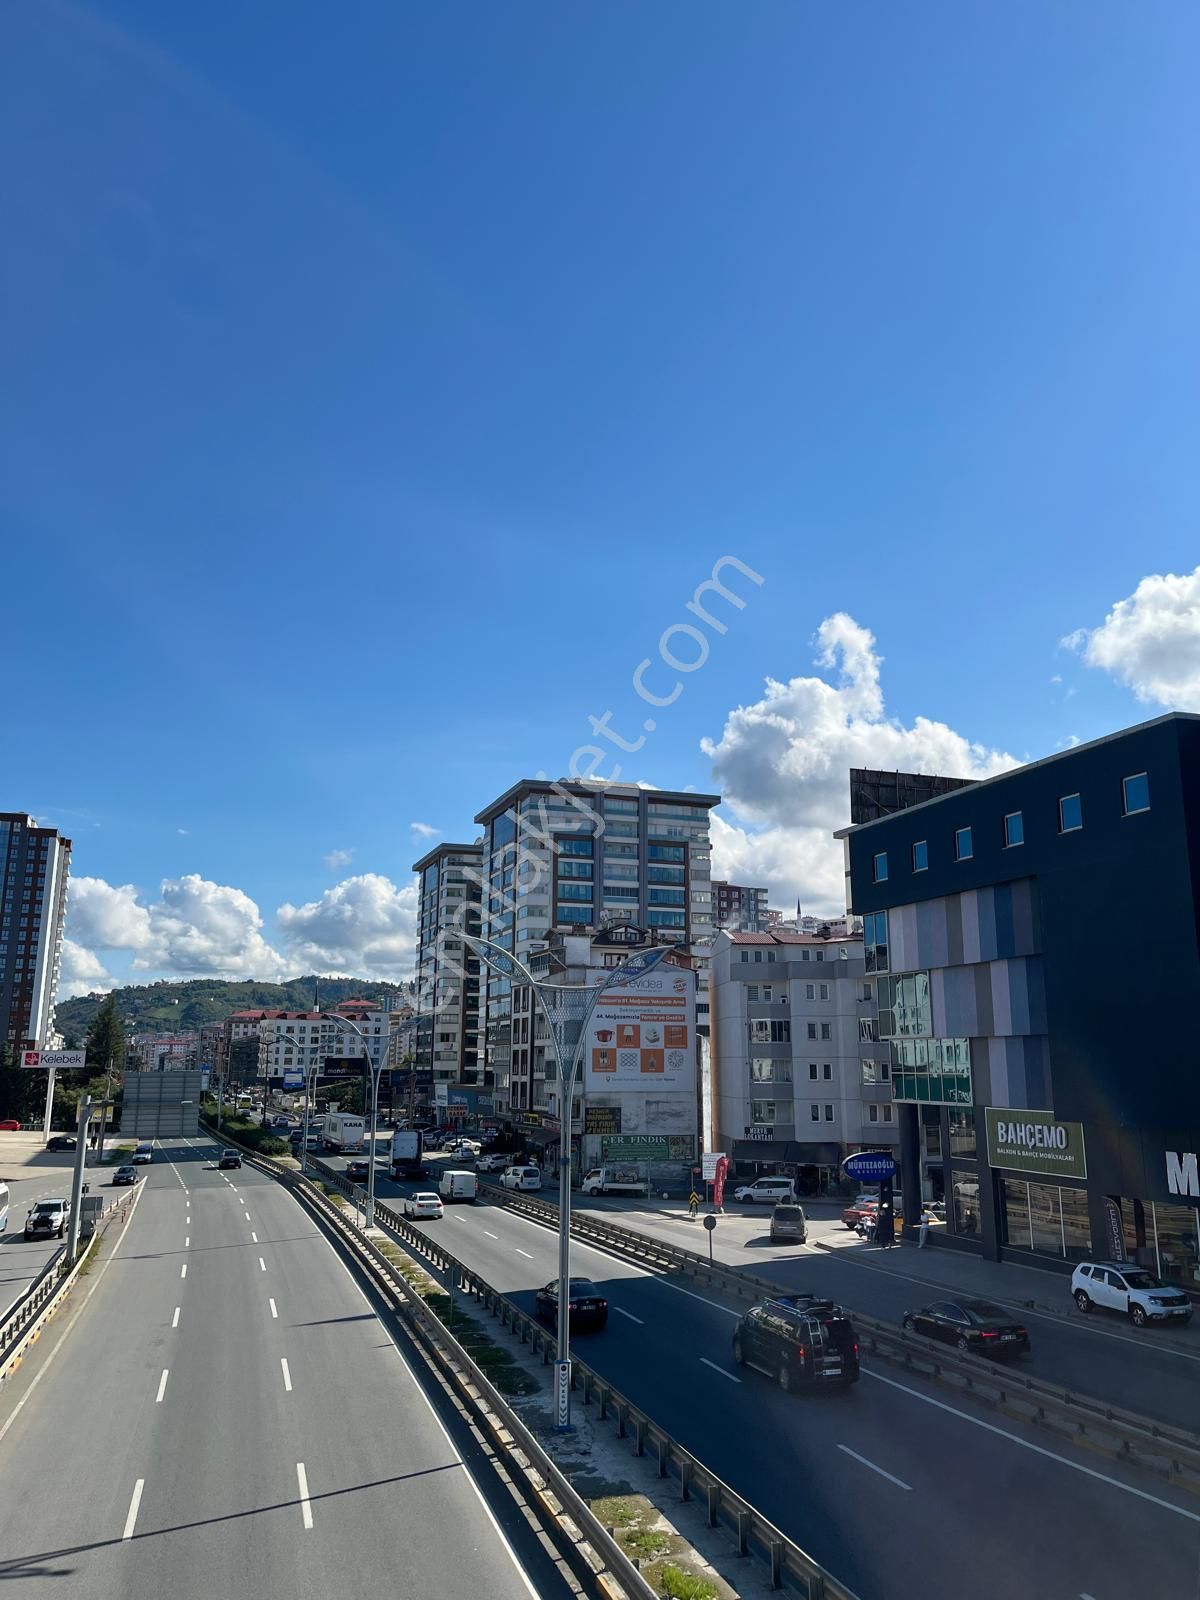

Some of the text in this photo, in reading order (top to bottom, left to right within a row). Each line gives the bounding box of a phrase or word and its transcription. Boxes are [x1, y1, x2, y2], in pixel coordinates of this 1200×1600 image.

[630, 980, 663, 988] evidea
[40, 1054, 82, 1064] Kelebek
[998, 1122, 1066, 1150] BAHÇEMO
[847, 1160, 894, 1169] MÜRTEZAOĞLU
